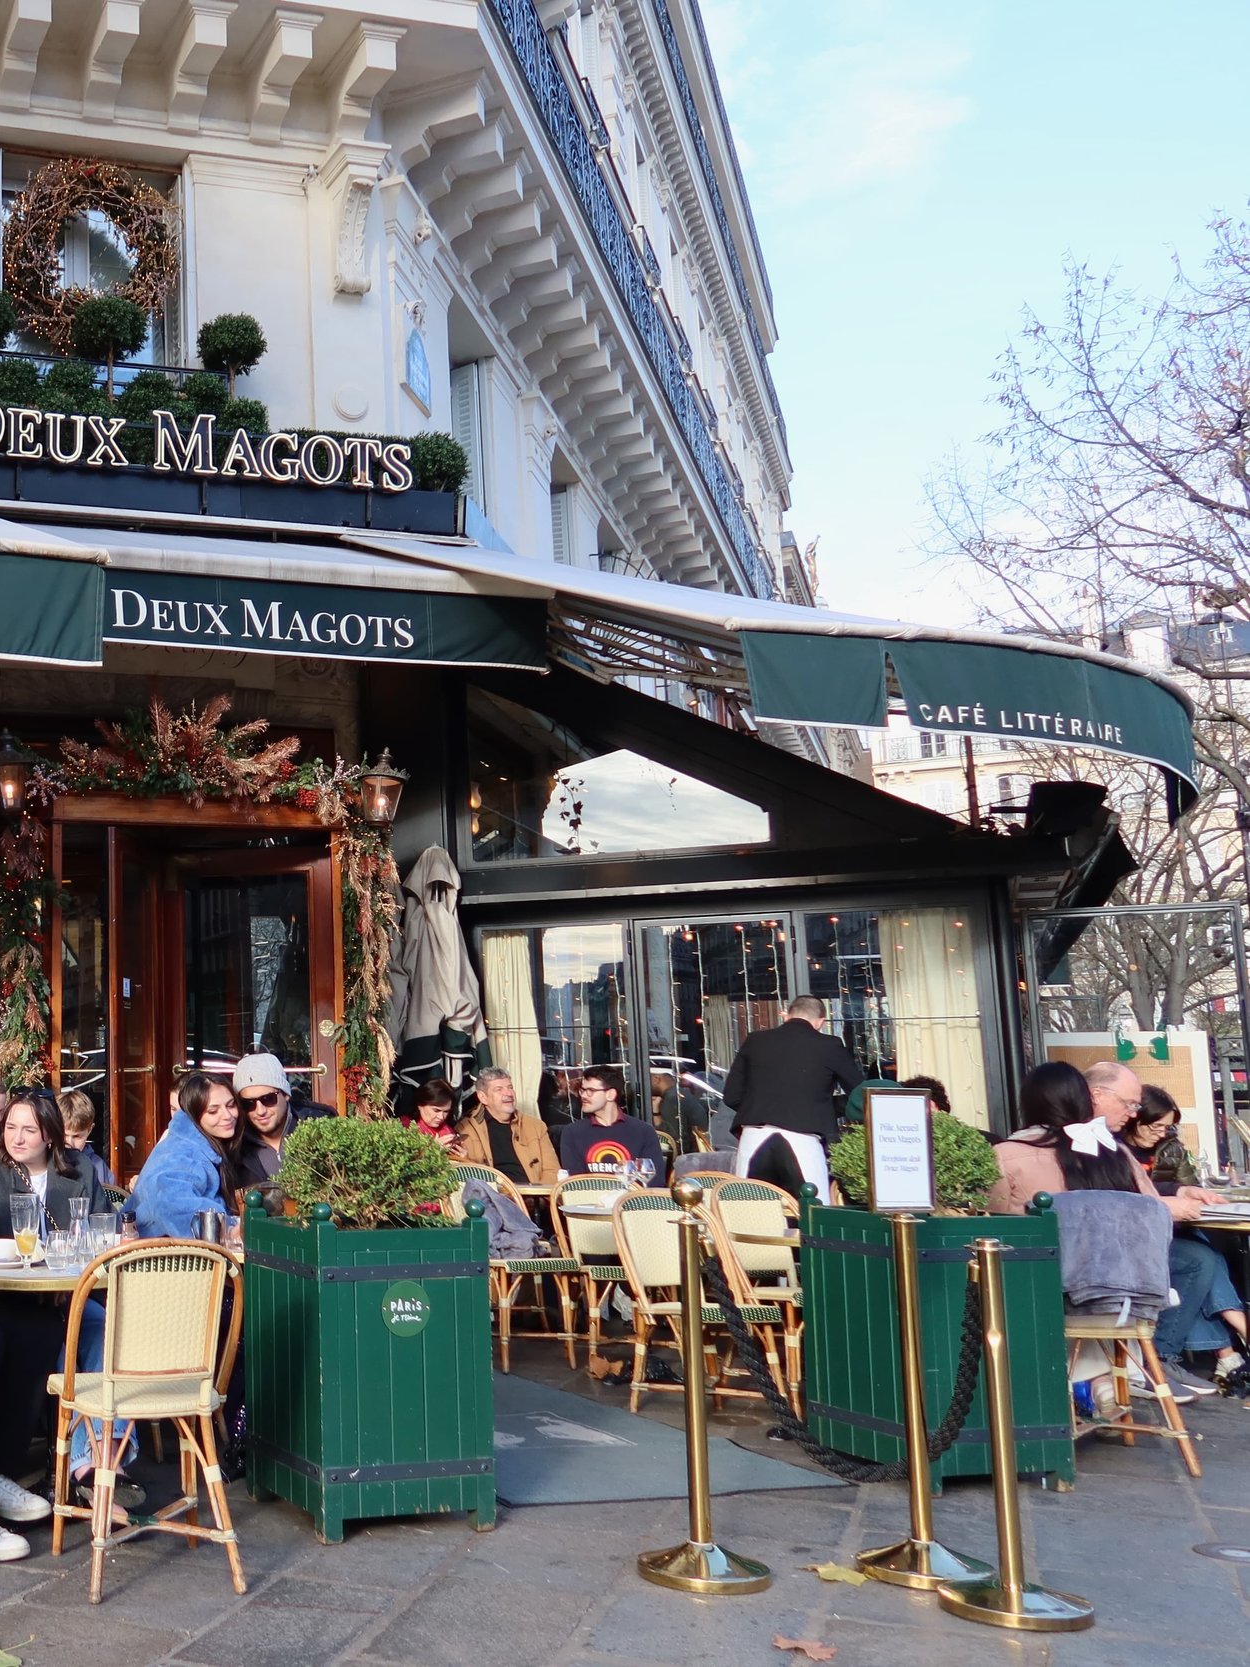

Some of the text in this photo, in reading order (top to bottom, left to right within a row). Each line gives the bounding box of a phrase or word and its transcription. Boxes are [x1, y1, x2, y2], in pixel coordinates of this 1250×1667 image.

[152, 409, 414, 492] MAGOTS
[110, 588, 415, 649] DEUX MAGOTS
[919, 702, 1124, 745] CAFÉ LITTÉRAIRE
[587, 1162, 624, 1173] FRENC
